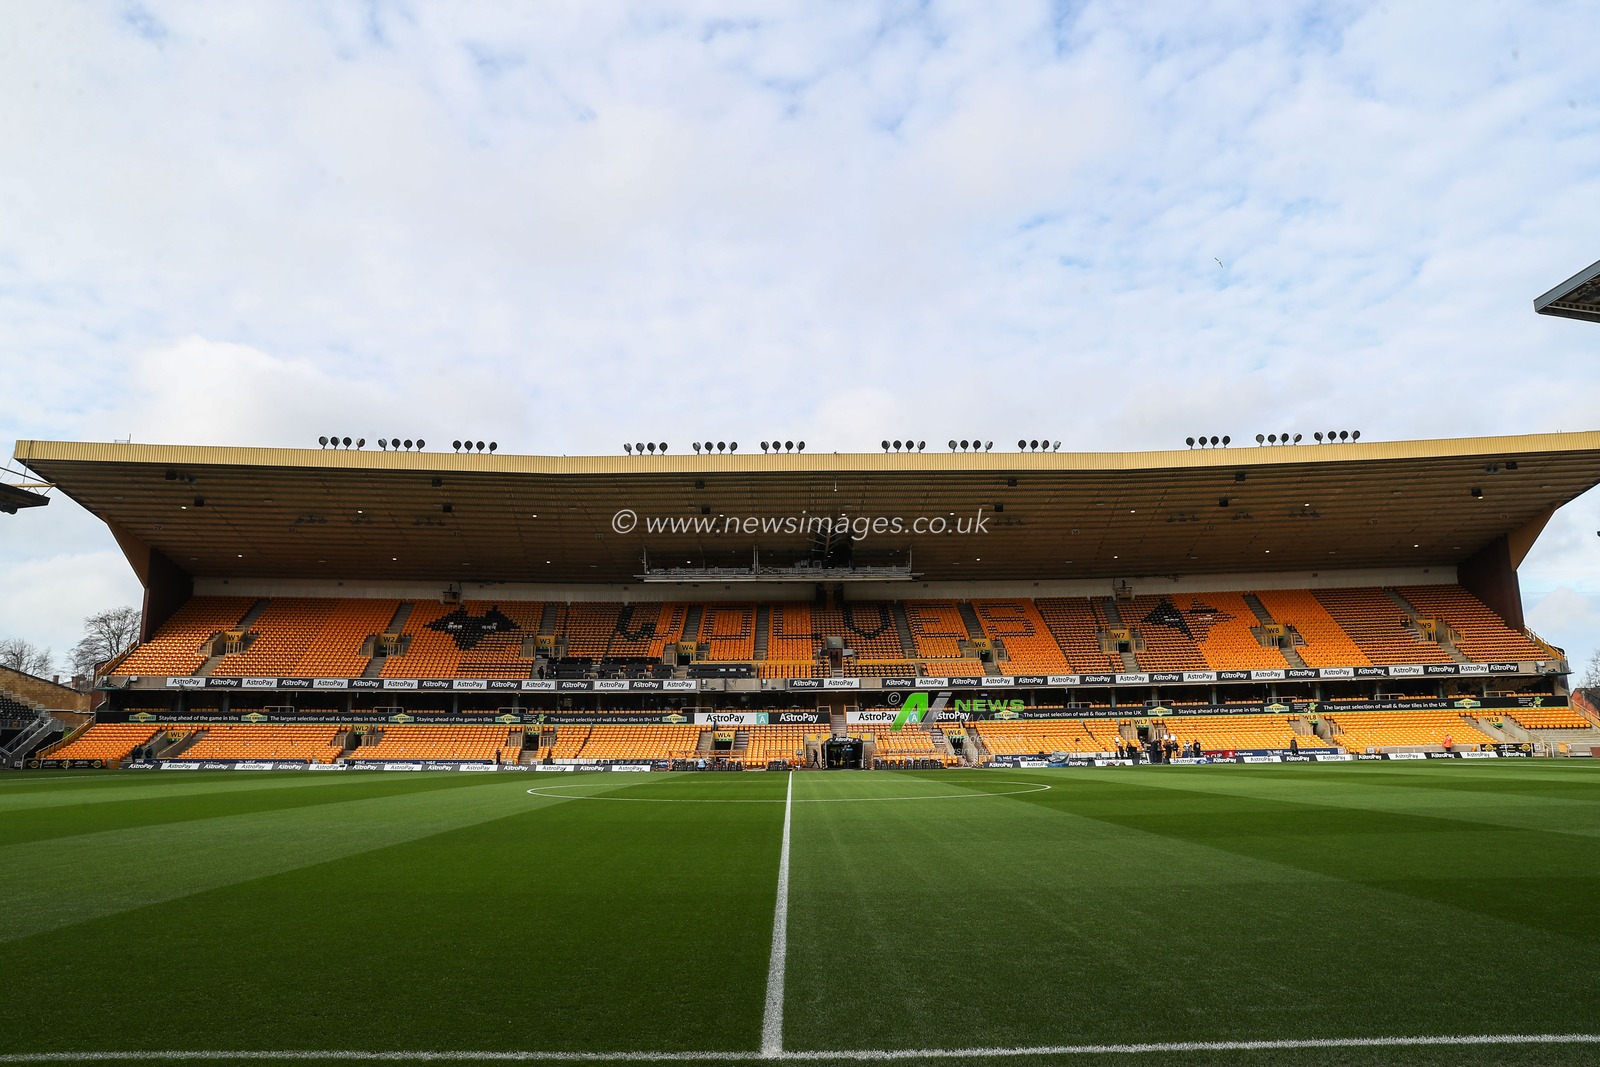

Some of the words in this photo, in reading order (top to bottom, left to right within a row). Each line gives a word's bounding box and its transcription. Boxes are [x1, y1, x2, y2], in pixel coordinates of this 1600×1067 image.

[1289, 670, 1315, 678] AstroPay
[1323, 669, 1350, 677] AstroPay
[1358, 668, 1384, 676] AstroPay
[706, 713, 744, 723] AstroPay
[780, 713, 818, 723] AstroPay
[858, 712, 896, 722] AstroPay
[932, 711, 970, 722] AstroPay
